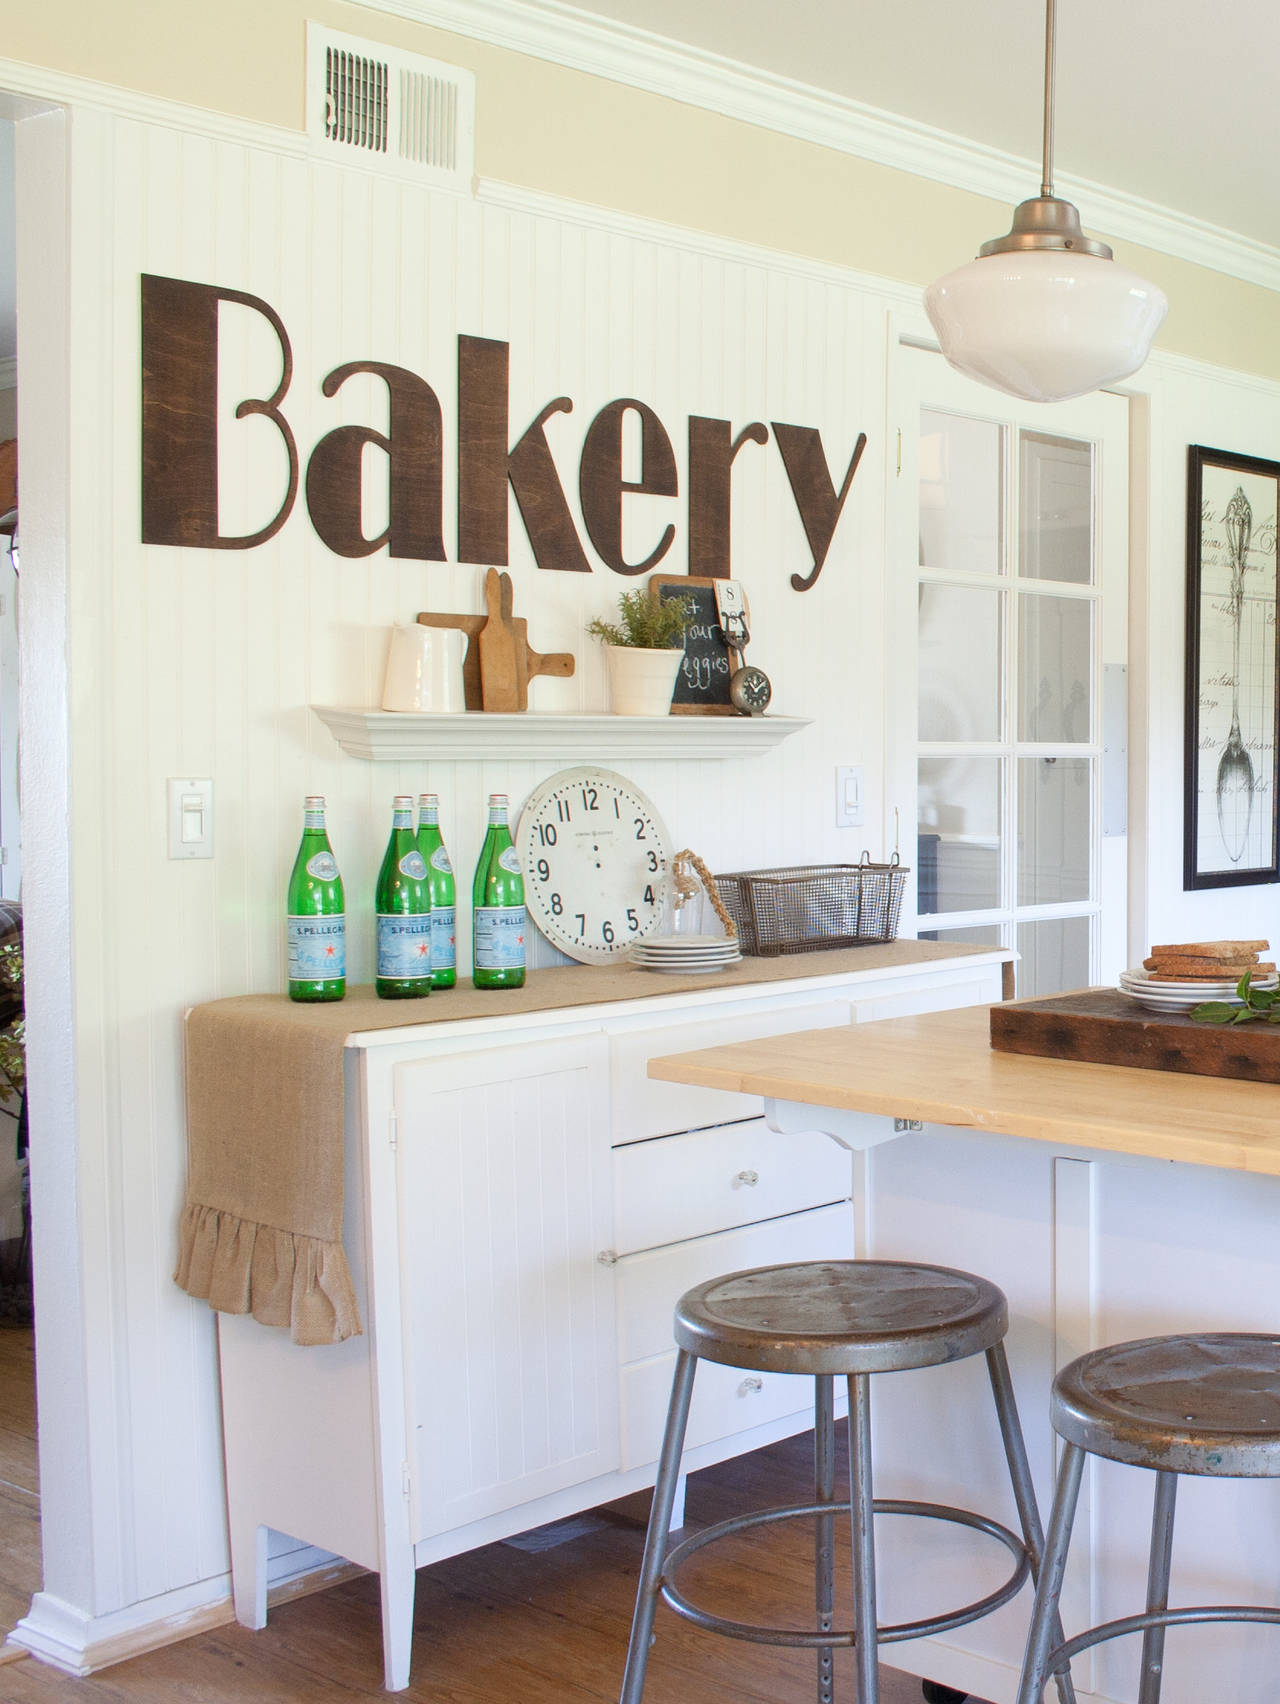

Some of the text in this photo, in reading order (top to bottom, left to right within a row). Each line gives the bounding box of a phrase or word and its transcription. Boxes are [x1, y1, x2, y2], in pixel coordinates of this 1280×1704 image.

[141, 272, 867, 593] Bakery
[582, 788, 599, 811] 12
[614, 798, 620, 819] 1
[557, 800, 571, 822] 11
[539, 824, 557, 846] 10
[634, 818, 646, 840] 2
[538, 859, 550, 882] 9
[647, 850, 658, 872] 3
[551, 893, 563, 915] 8
[644, 885, 655, 906] 4
[575, 914, 586, 936] 7
[627, 909, 639, 931] 5
[602, 921, 614, 944] 6
